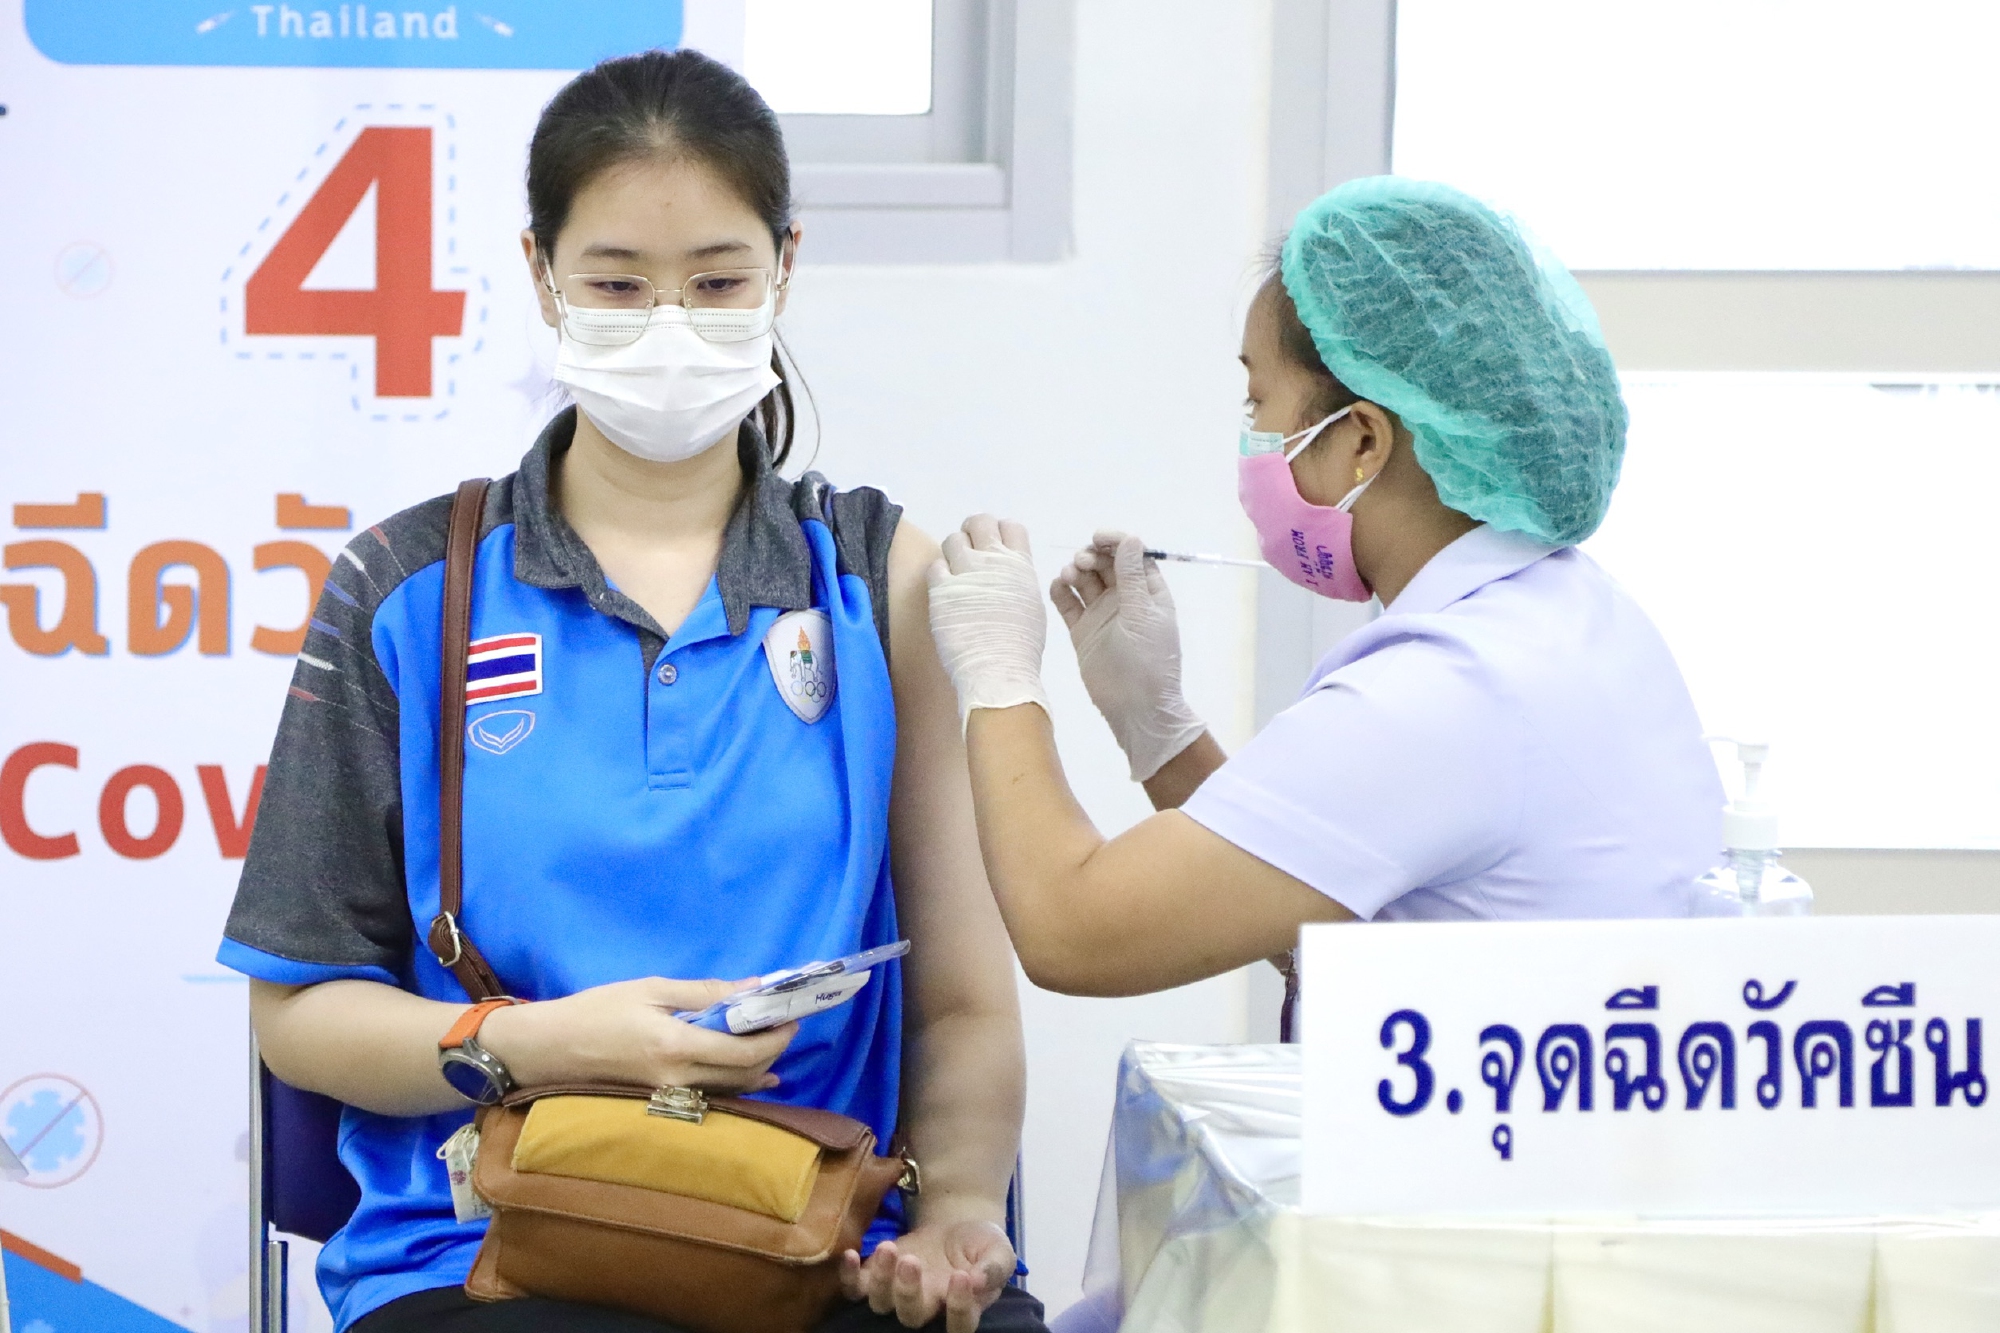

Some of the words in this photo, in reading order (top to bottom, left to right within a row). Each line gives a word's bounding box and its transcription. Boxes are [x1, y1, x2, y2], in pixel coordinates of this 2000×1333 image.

[251, 3, 459, 39] Thailand
[244, 126, 467, 398] 4
[1291, 529, 1309, 560] FROM
